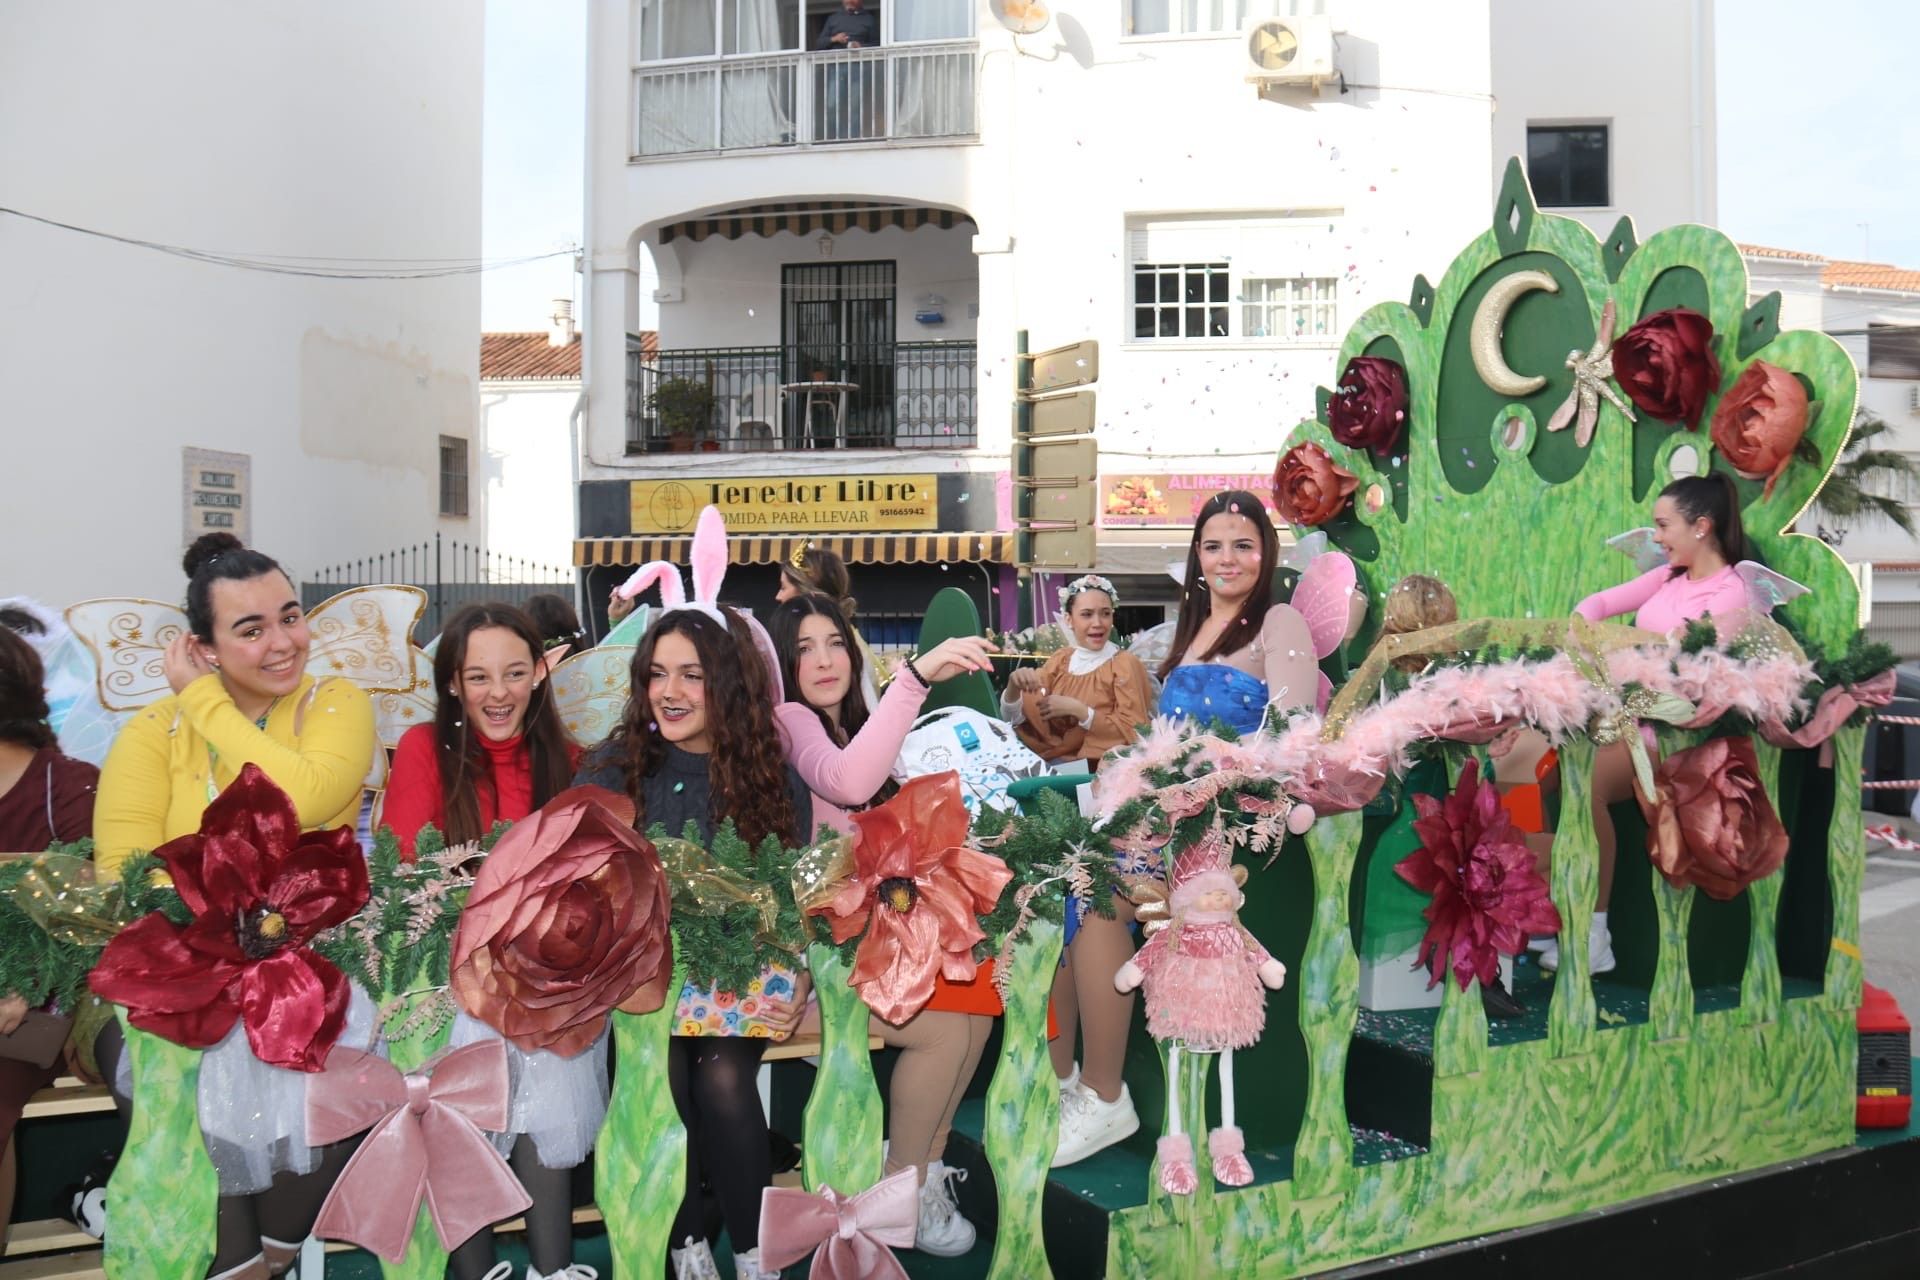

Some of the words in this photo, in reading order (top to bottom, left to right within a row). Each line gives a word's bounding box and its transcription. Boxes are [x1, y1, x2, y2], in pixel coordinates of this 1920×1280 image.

[1168, 475, 1276, 490] ALIMENTAC
[704, 482, 827, 504] Tenedor
[836, 479, 916, 502] Libre
[718, 511, 767, 524] OMIDA
[772, 511, 809, 524] PARA
[814, 510, 869, 523] LLEVAR
[879, 507, 925, 517] 951665942
